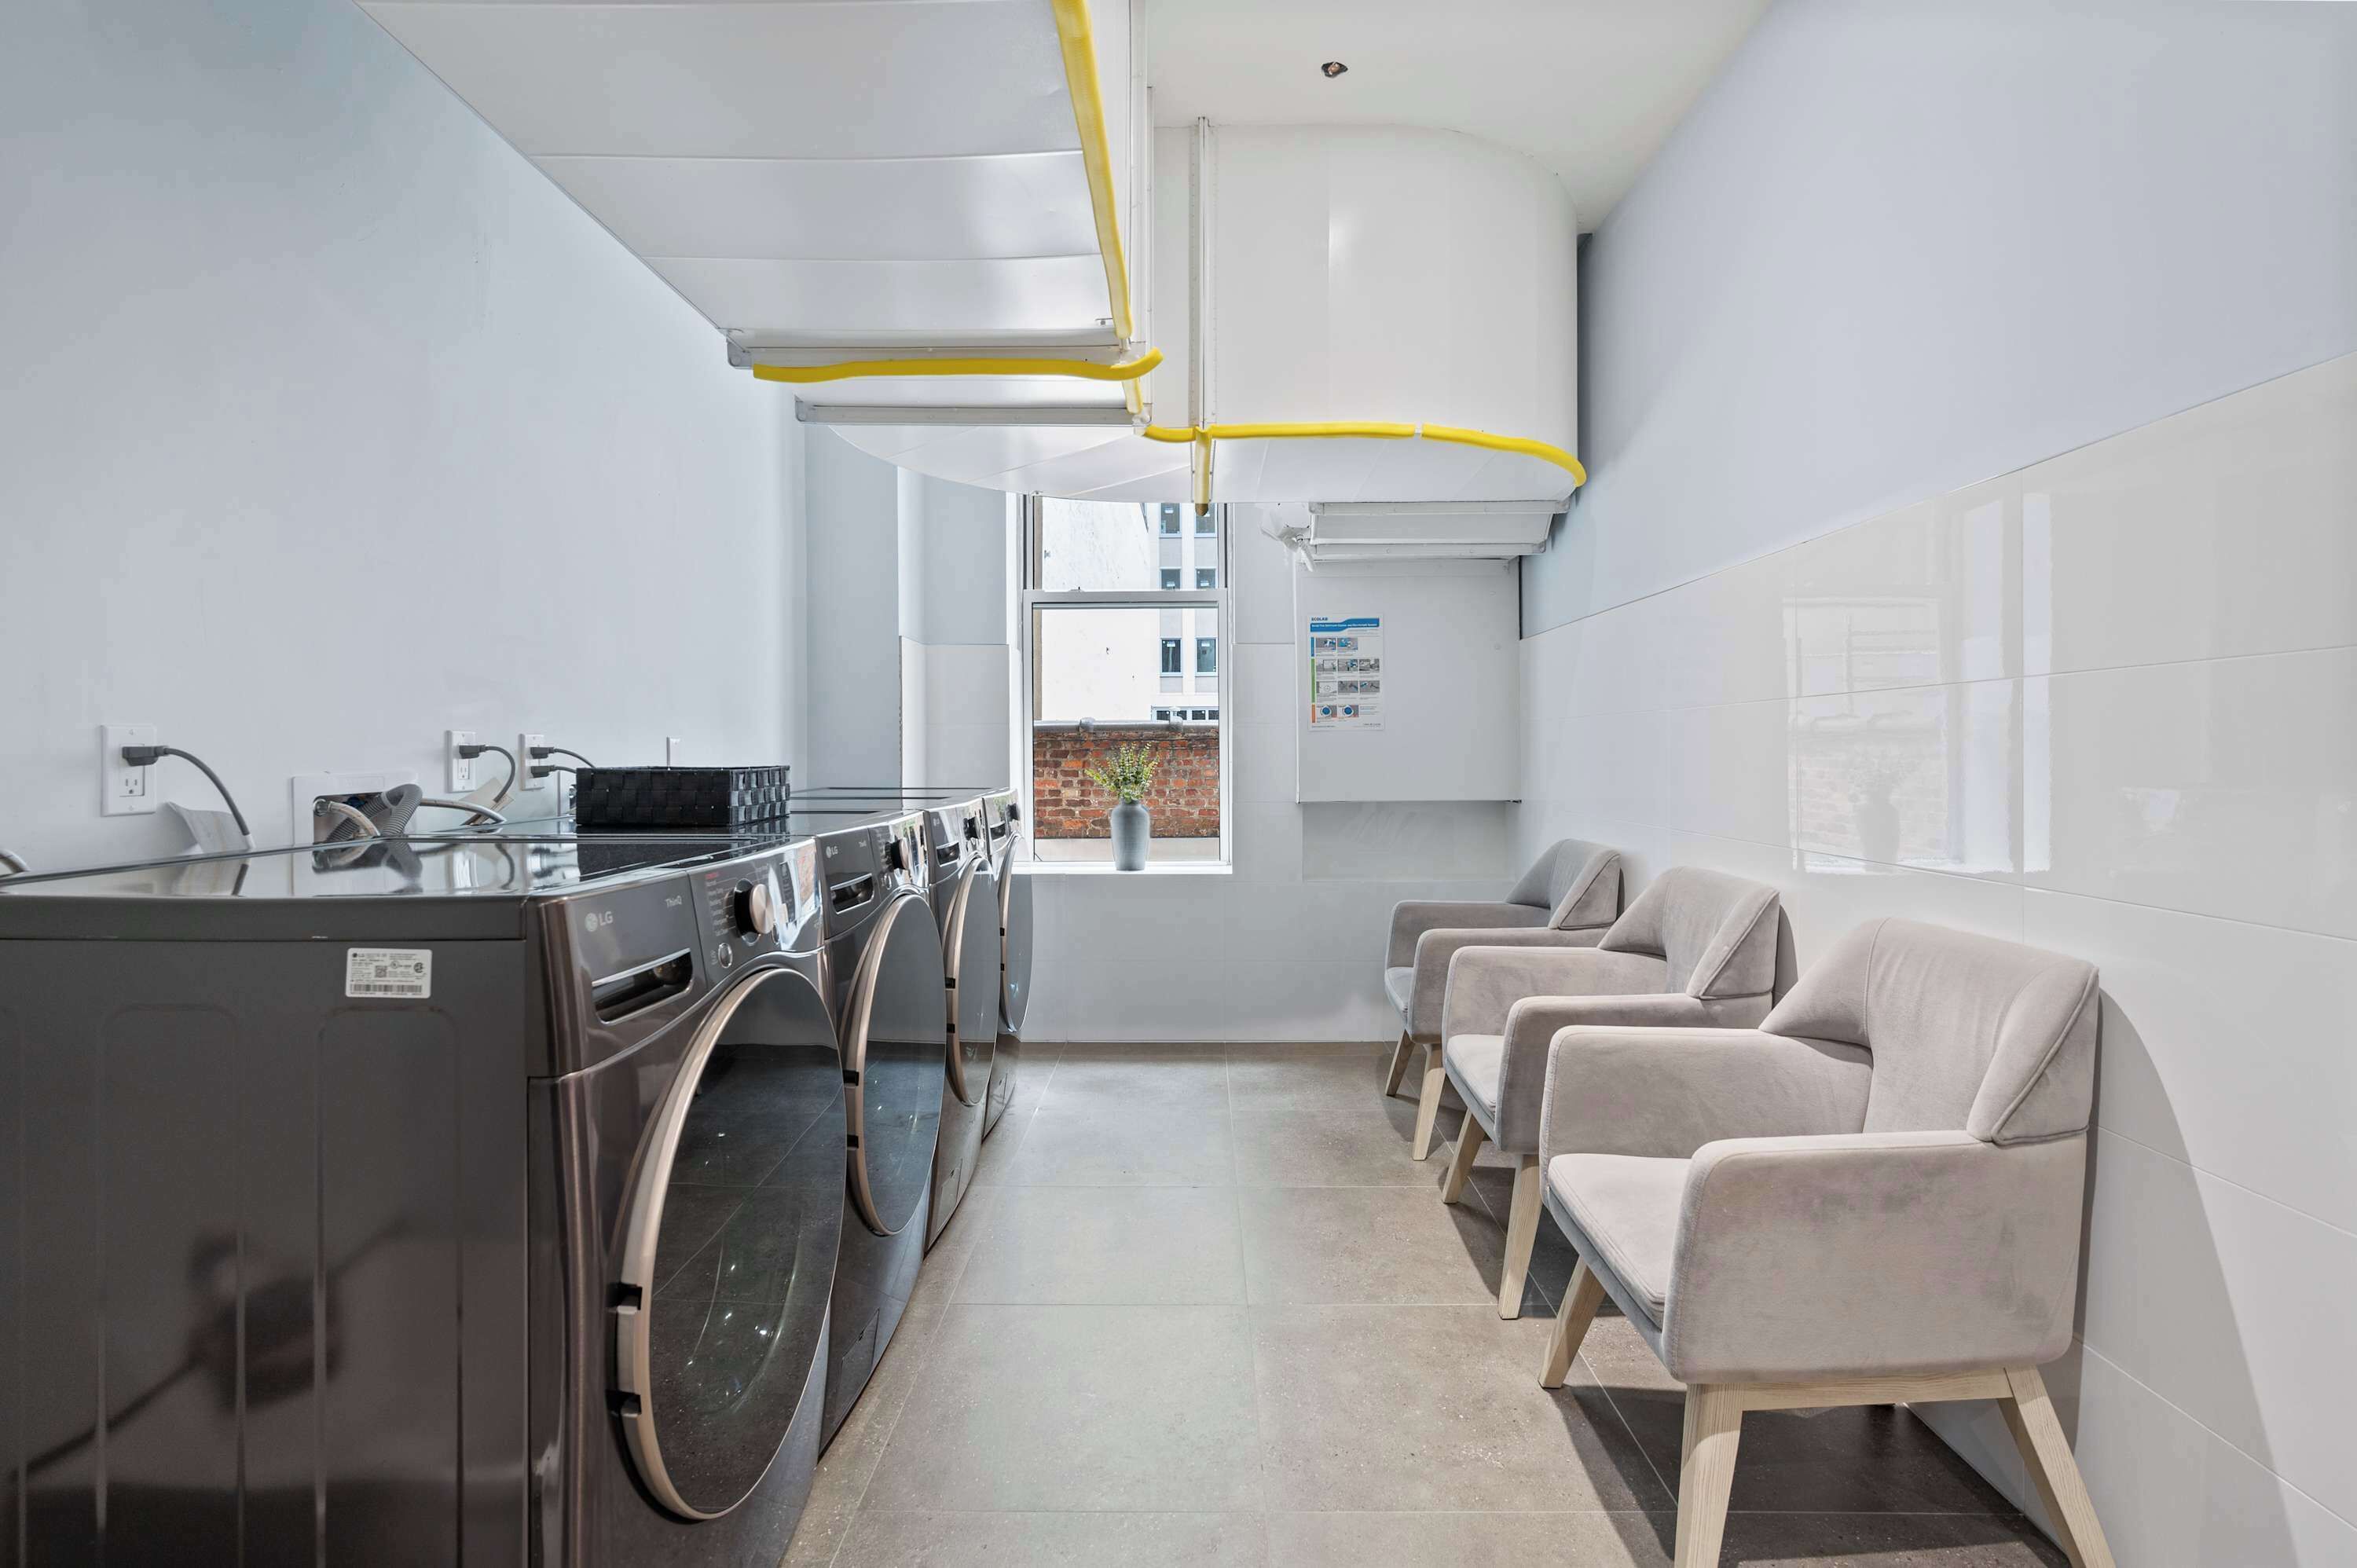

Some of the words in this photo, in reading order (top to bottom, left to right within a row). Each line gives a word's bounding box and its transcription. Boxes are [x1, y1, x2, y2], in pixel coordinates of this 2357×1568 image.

[831, 846, 838, 855] LG
[665, 895, 682, 907] ThinQ
[599, 911, 613, 926] LG
